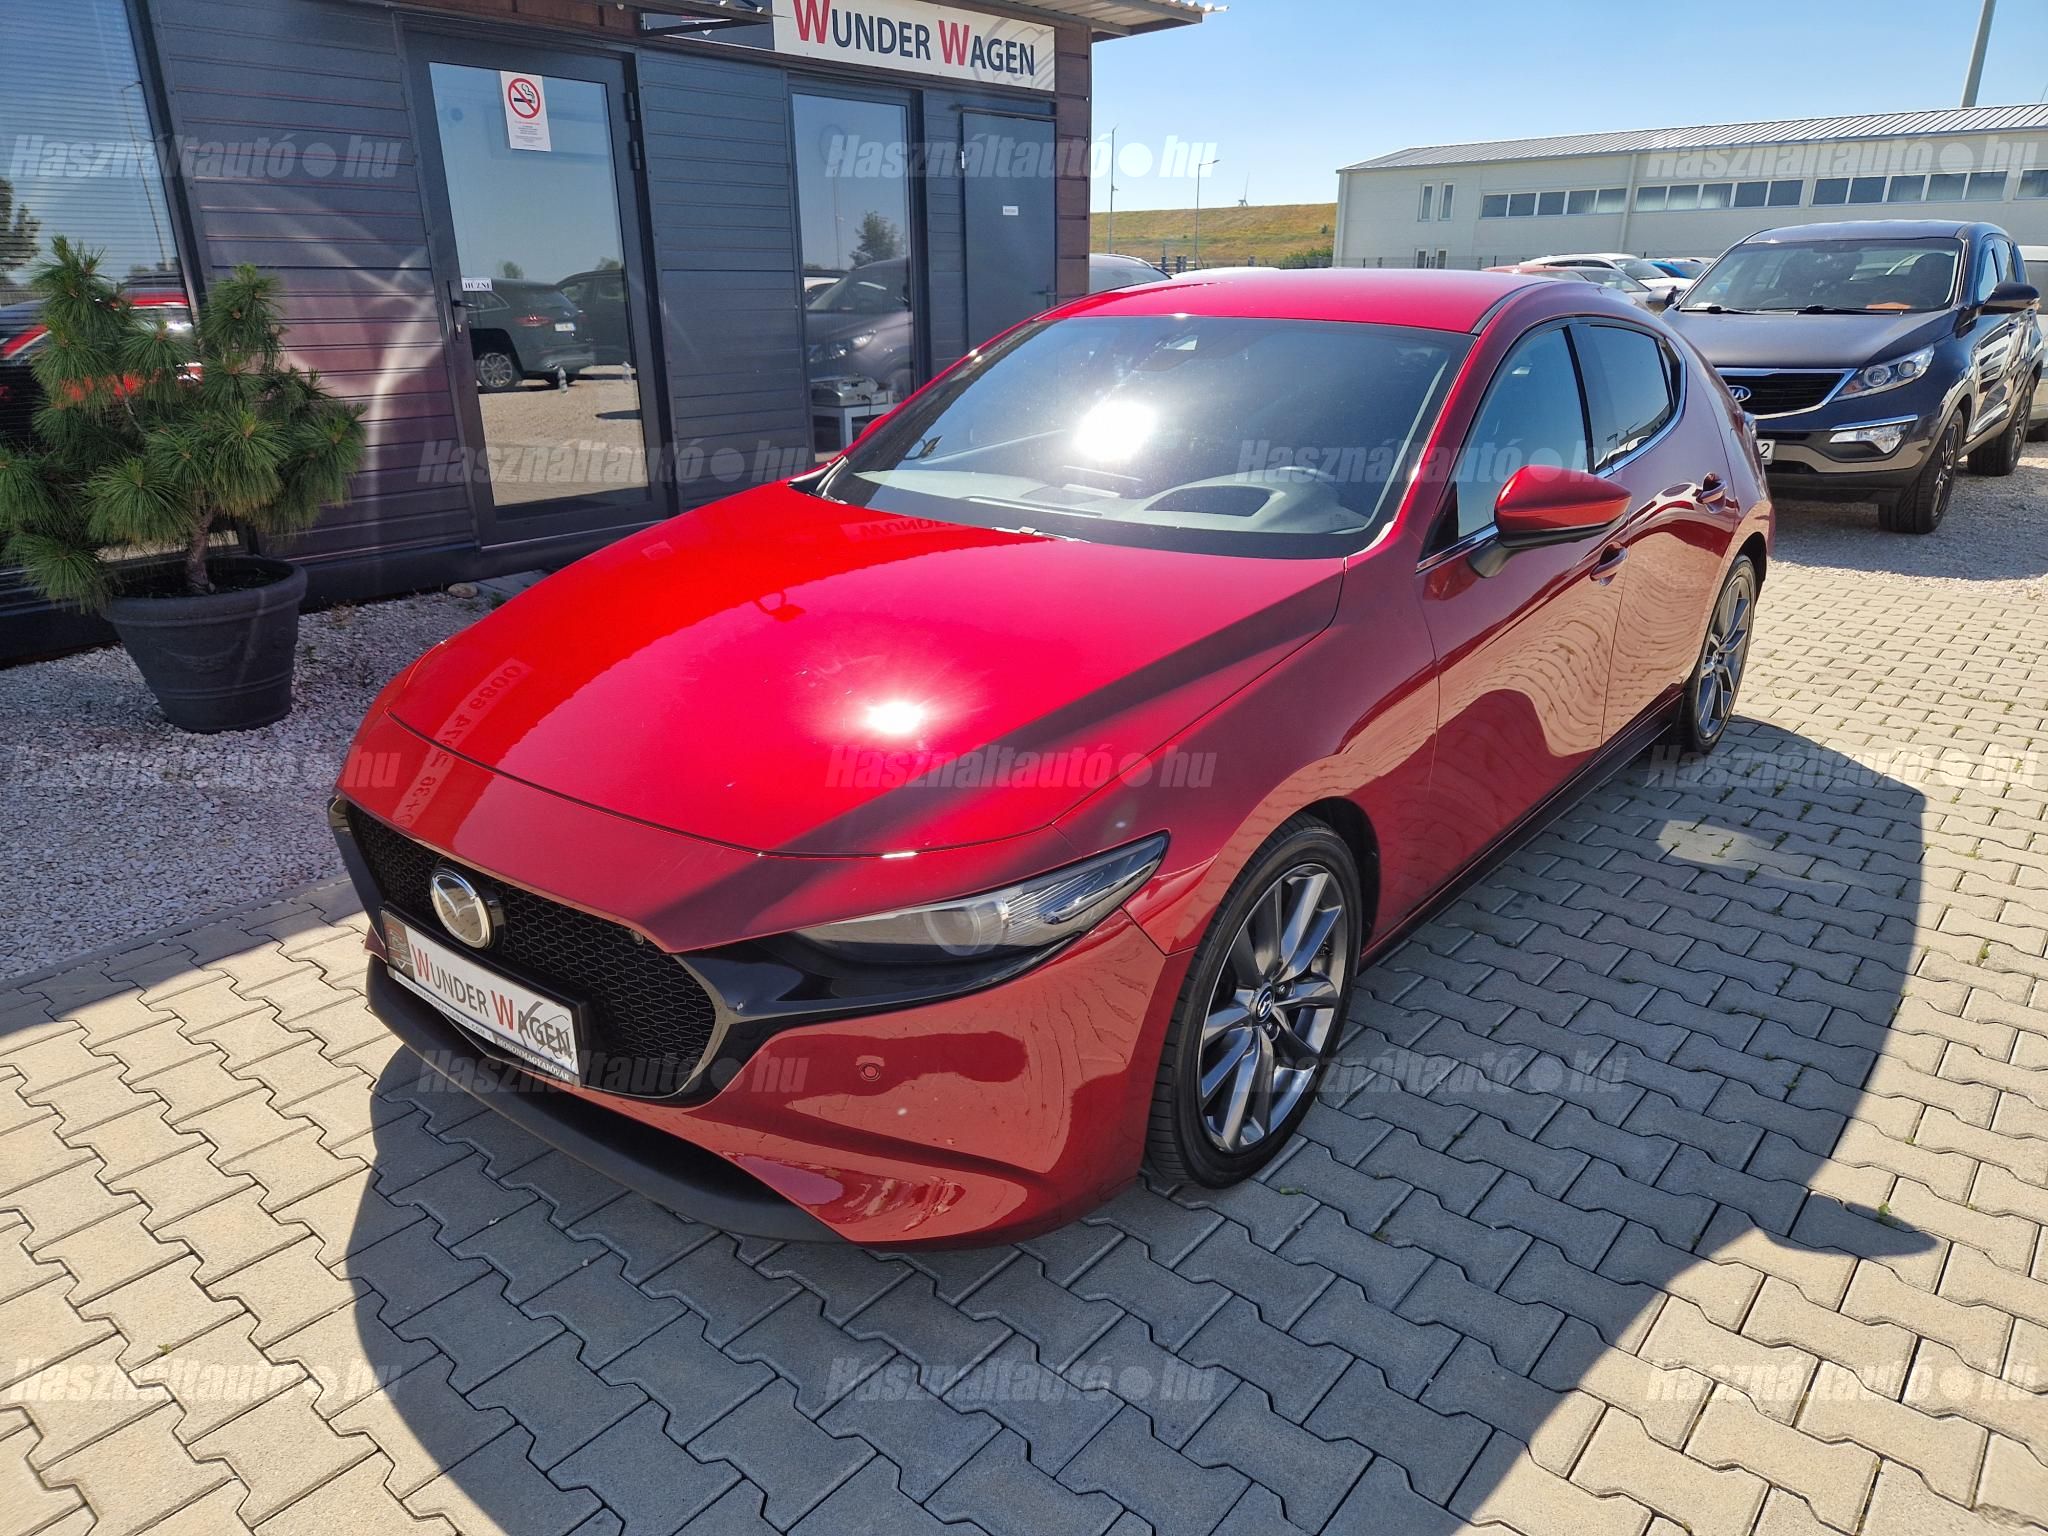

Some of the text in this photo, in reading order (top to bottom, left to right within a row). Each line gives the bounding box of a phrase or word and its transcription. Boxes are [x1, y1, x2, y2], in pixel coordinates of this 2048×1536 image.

[793, 0, 1035, 76] WUNDER WAGEN
[411, 943, 572, 1057] WUNDER WAGEN
